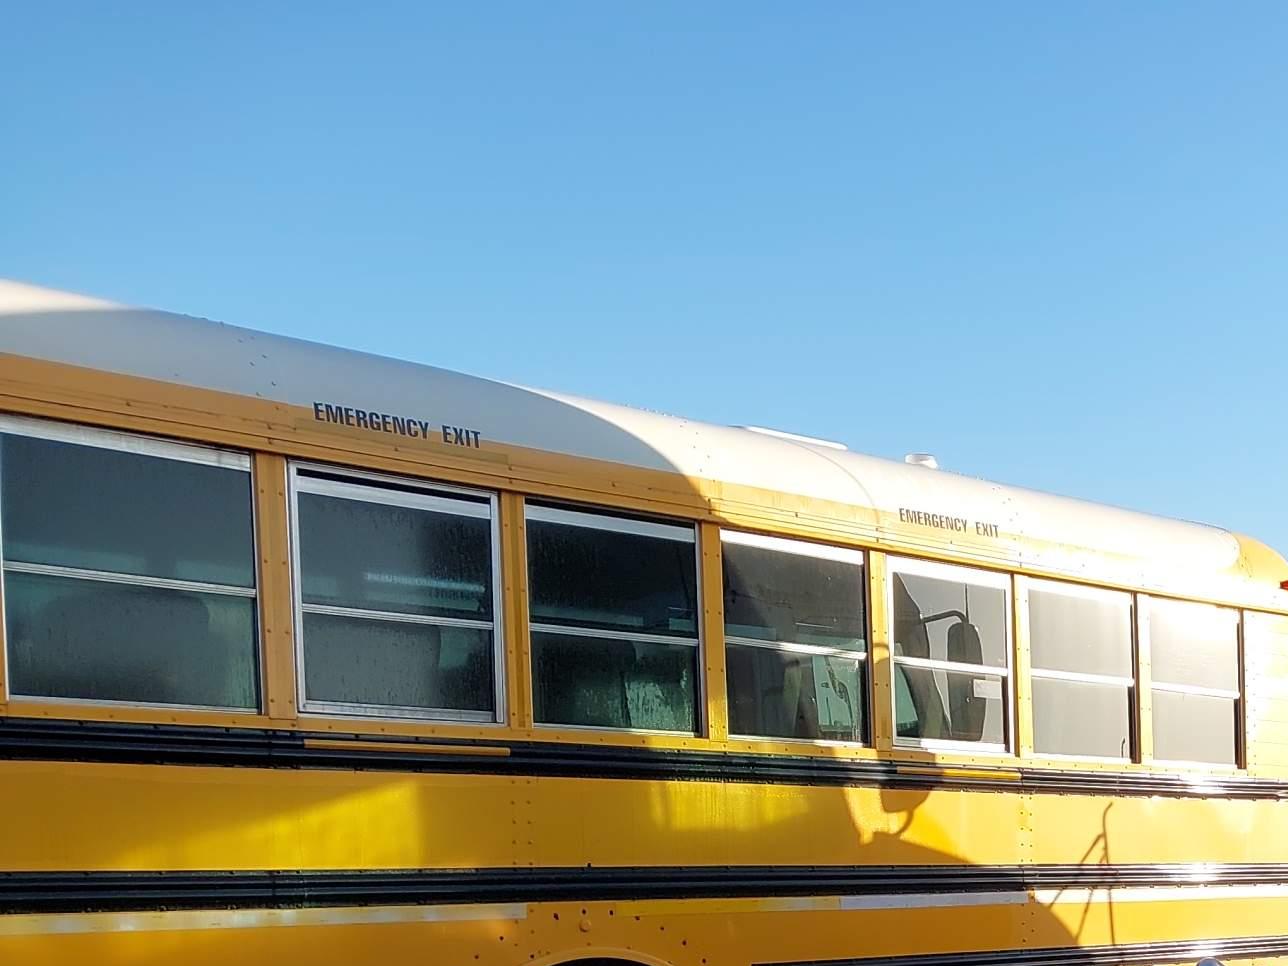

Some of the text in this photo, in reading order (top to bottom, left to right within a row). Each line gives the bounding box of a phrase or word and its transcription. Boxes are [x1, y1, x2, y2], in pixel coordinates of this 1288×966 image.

[313, 402, 481, 448] EMERGENCY EXIT
[899, 508, 999, 538] EMERGENCY EXIT
